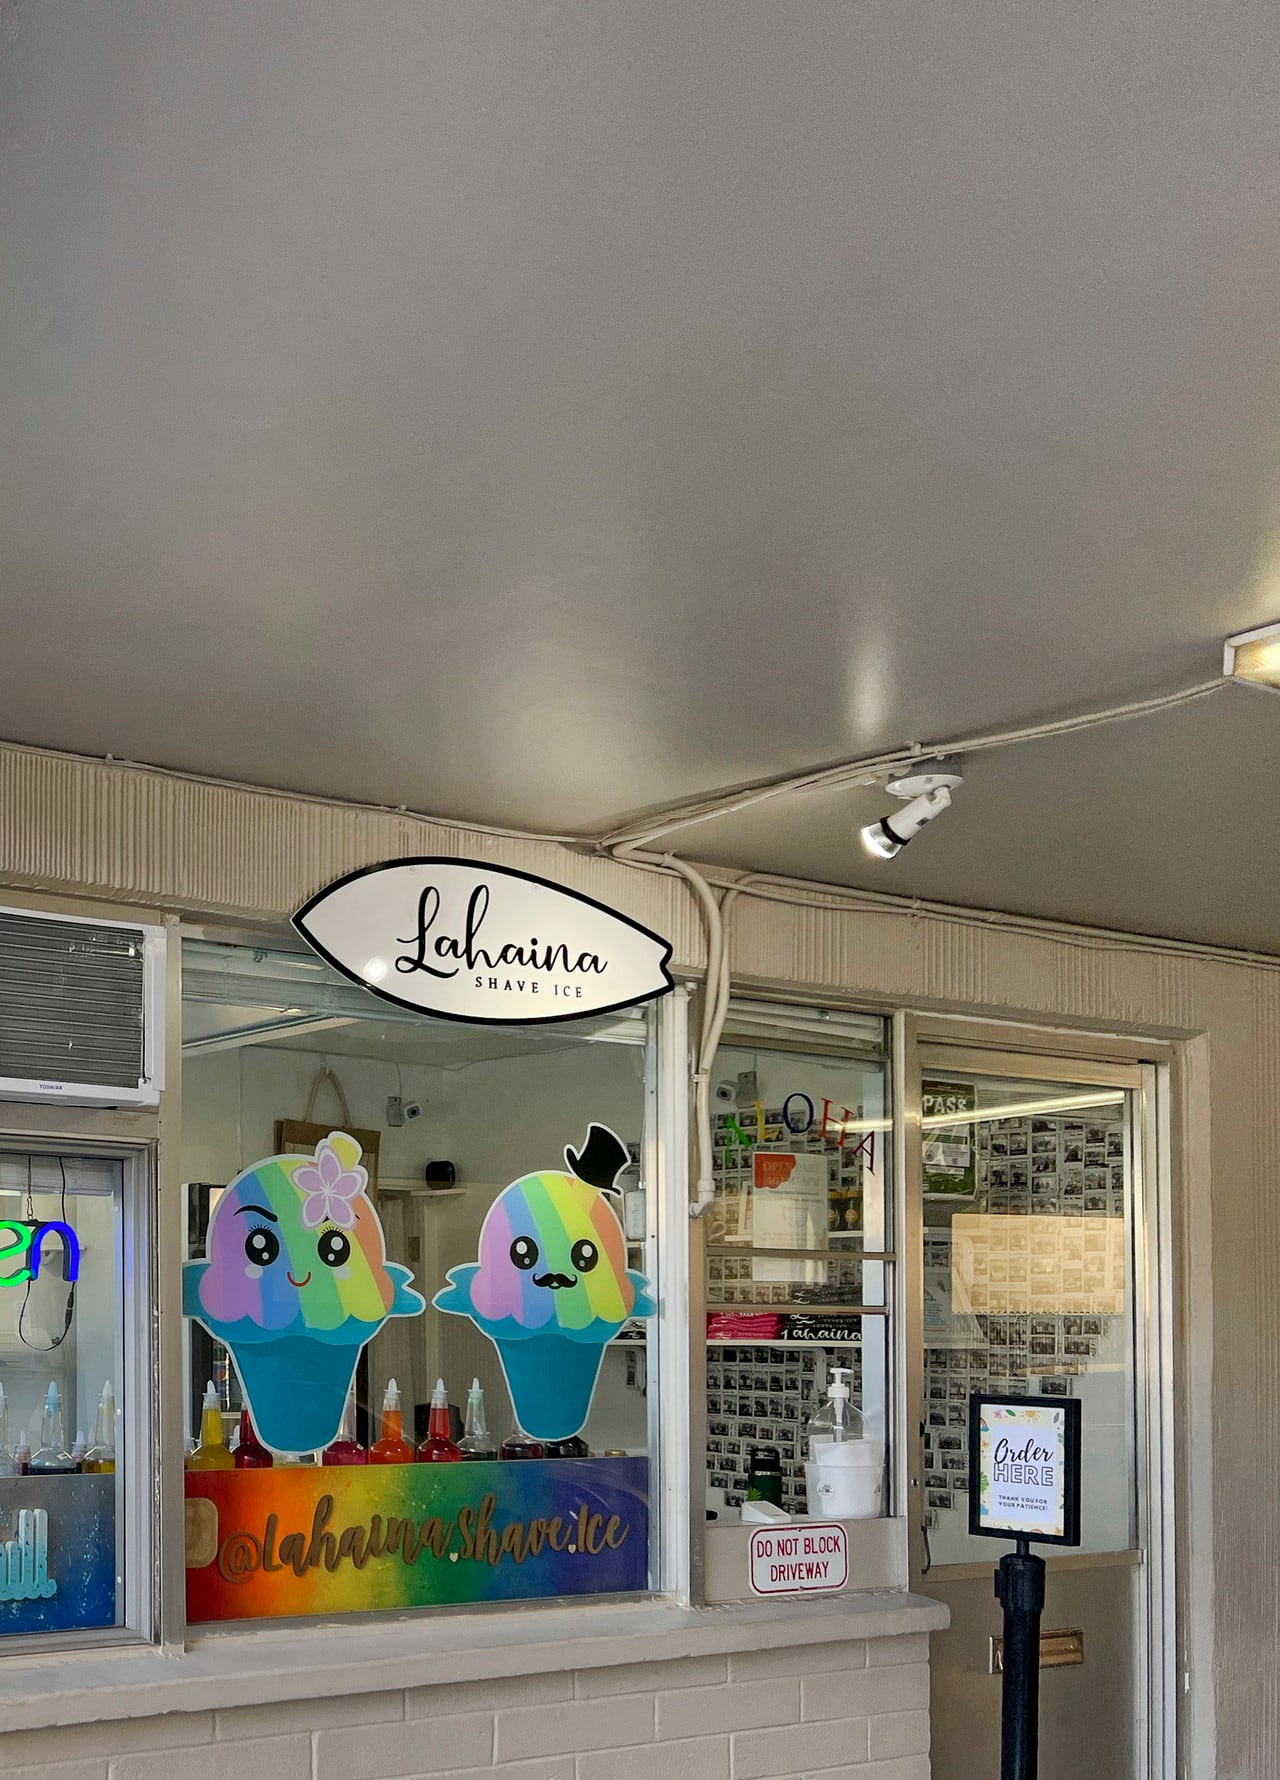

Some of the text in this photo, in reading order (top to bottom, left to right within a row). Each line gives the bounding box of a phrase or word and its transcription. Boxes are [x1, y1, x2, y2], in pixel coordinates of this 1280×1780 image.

[395, 884, 608, 979] Lahaina
[475, 976, 583, 998] SHAVE ICE
[724, 1092, 876, 1176] ALOHA
[994, 1438, 1054, 1464] Order
[993, 1462, 1054, 1487] HERE
[999, 1494, 1019, 1502] THANK
[756, 1535, 841, 1558] DO NOT BLOCK
[770, 1561, 829, 1582] DRIVEWAY
